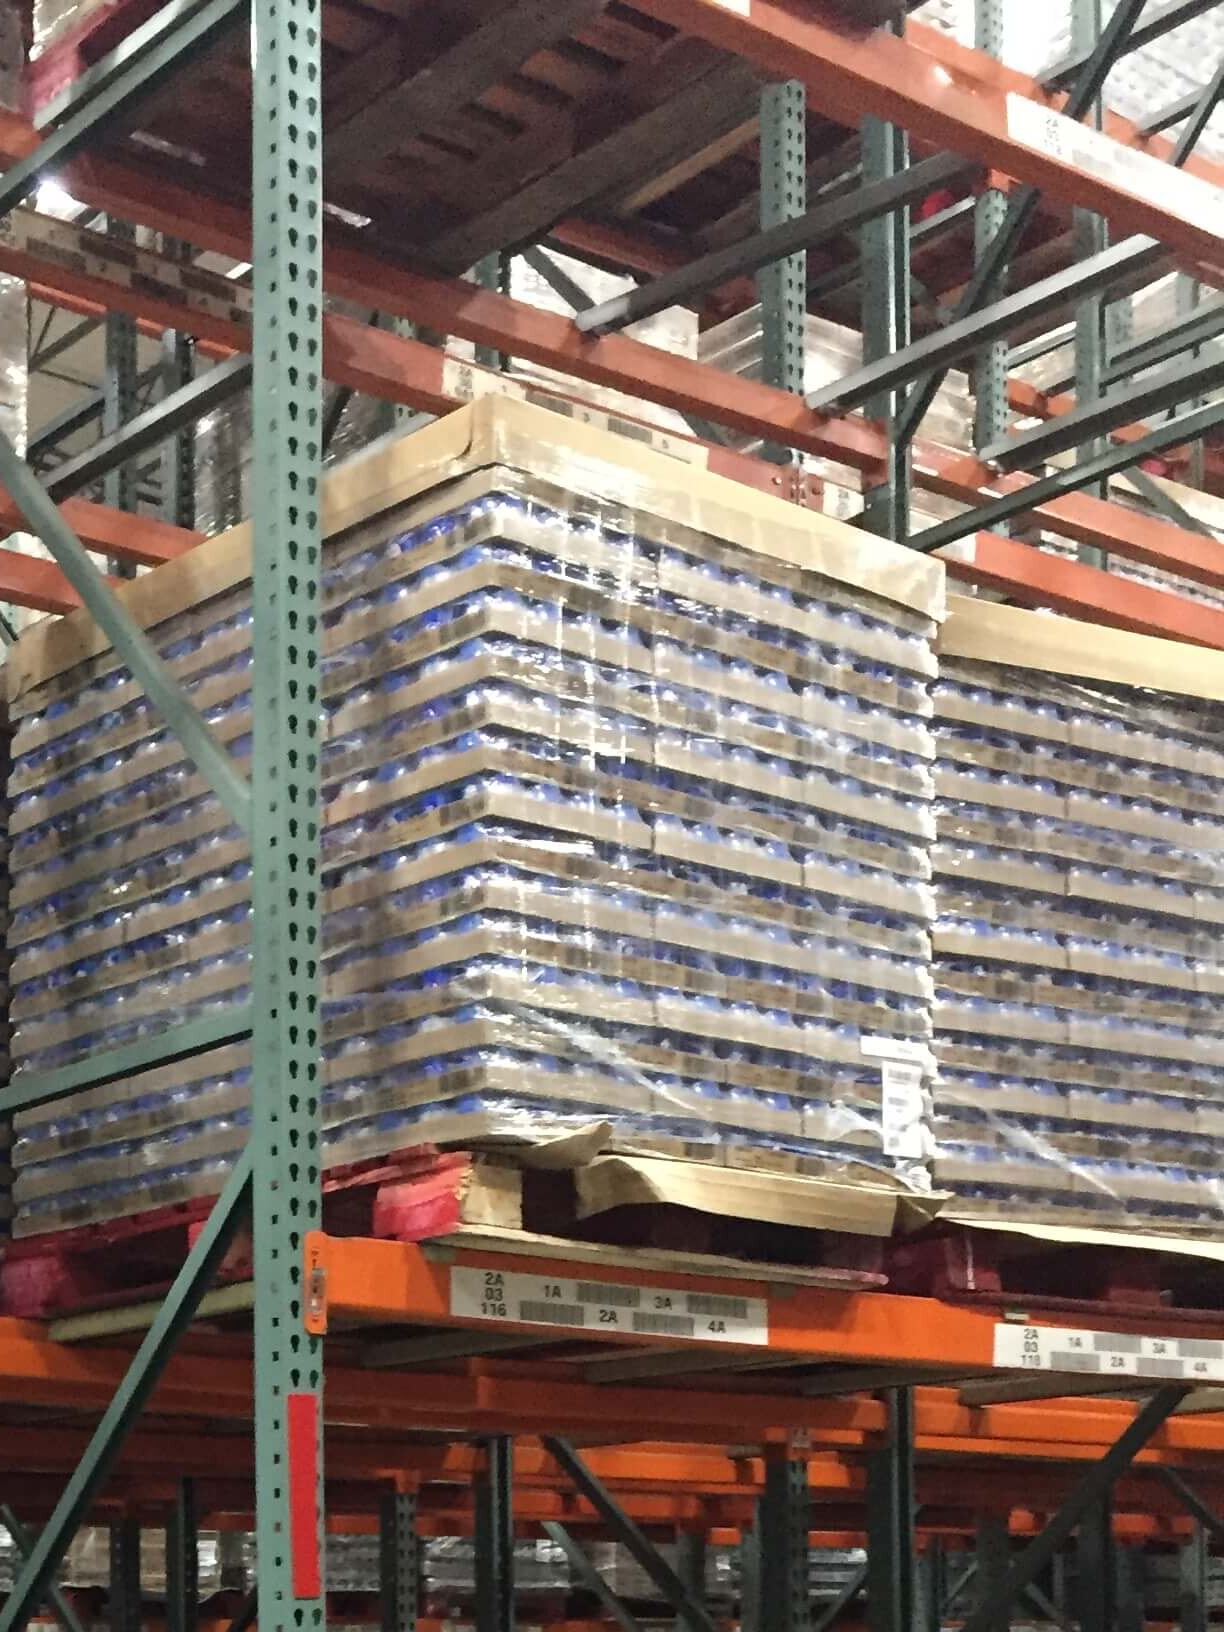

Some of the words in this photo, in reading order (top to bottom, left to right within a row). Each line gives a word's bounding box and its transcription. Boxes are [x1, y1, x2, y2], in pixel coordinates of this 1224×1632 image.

[484, 1272, 504, 1286] 2A
[485, 1287, 503, 1301] 03
[544, 1285, 561, 1298] 1A
[481, 1302, 507, 1316] 116
[654, 1296, 672, 1310] 3A
[599, 1309, 618, 1323] 2A
[707, 1320, 726, 1333] 4A
[1024, 1328, 1038, 1340] 2A
